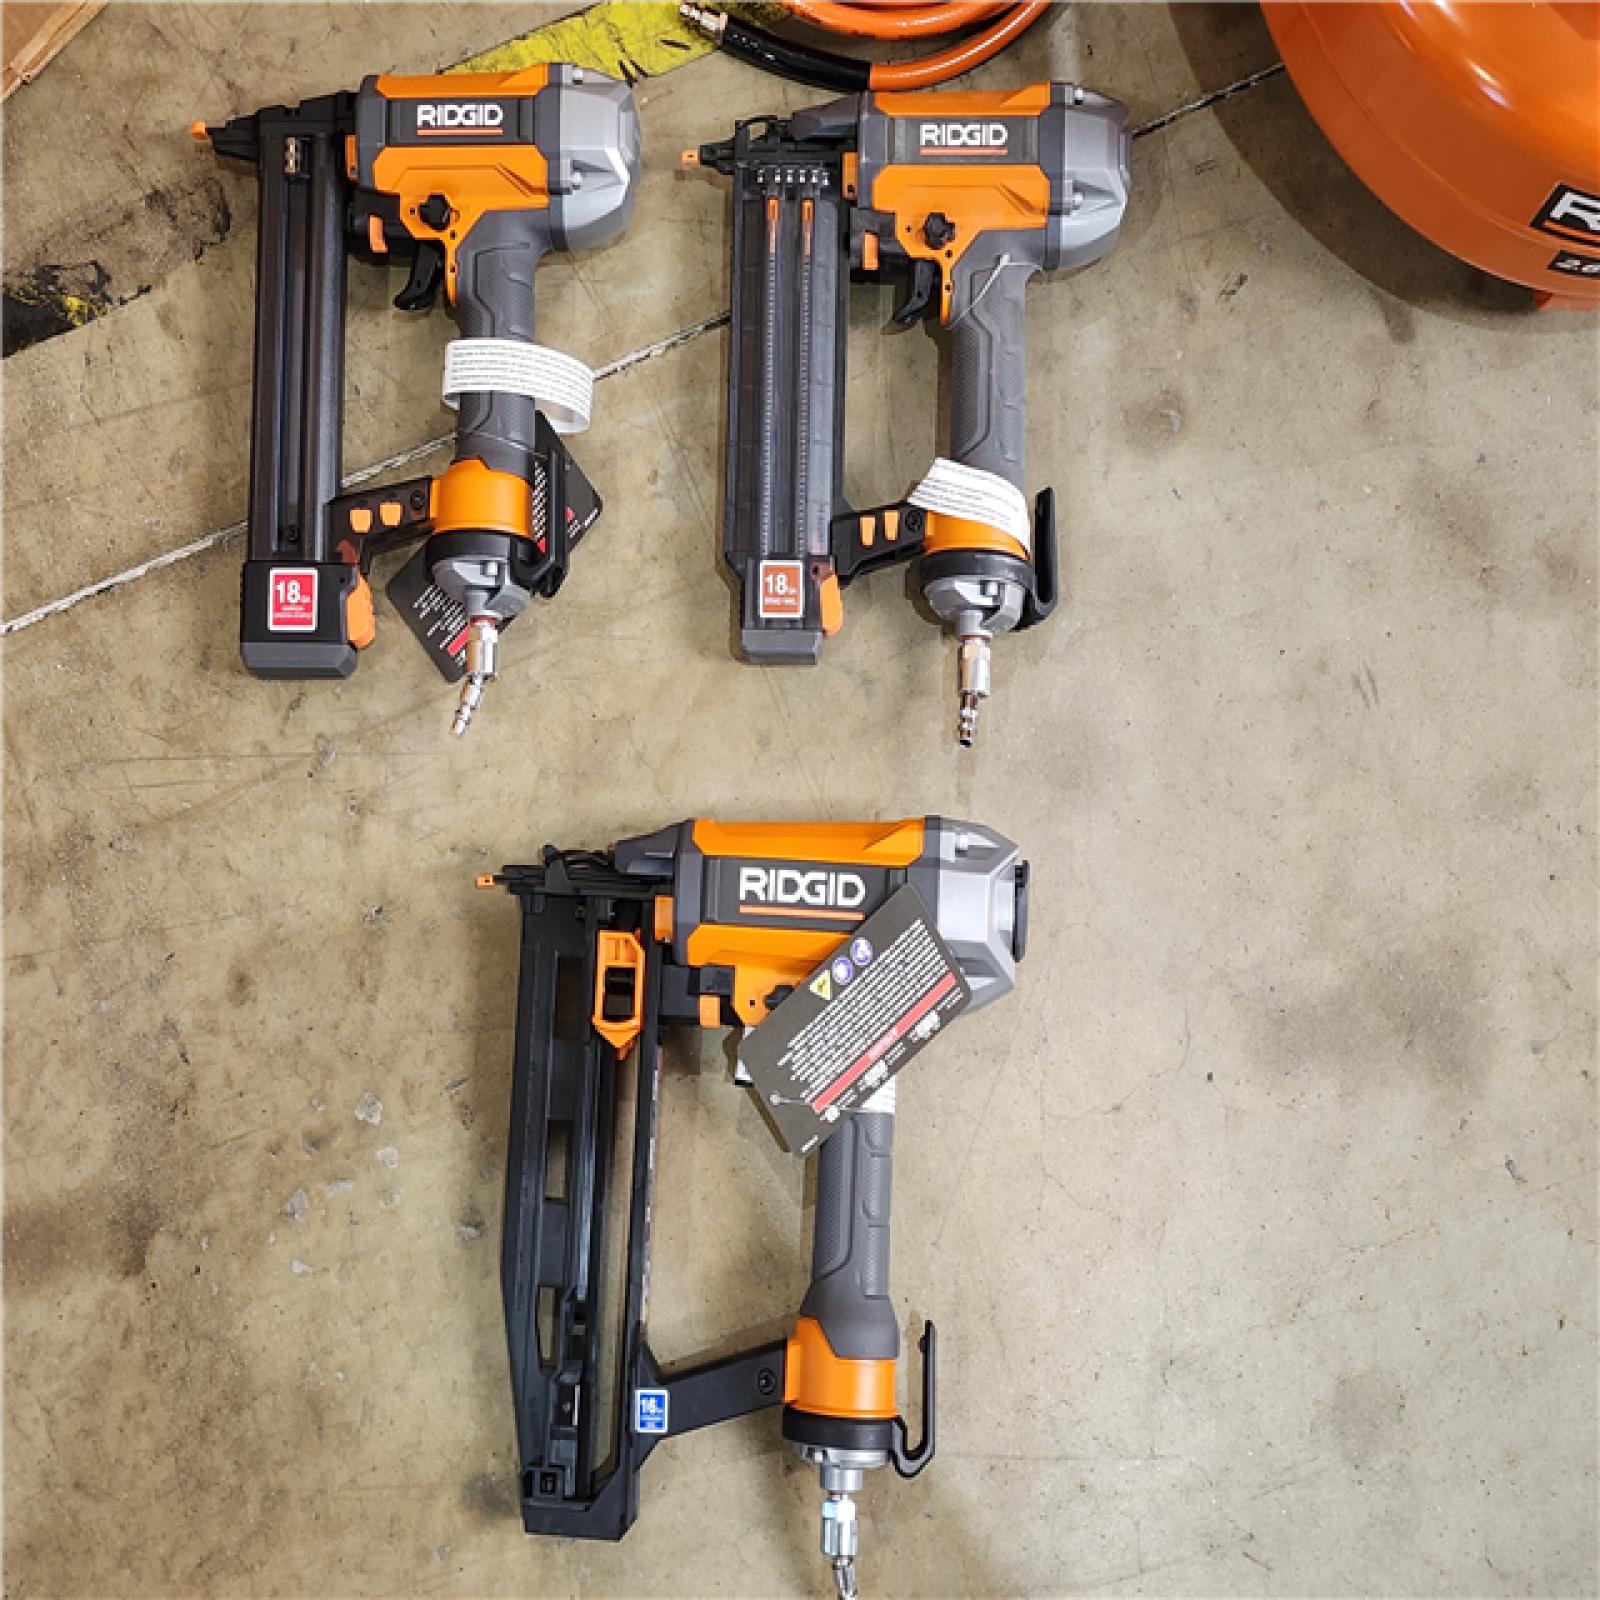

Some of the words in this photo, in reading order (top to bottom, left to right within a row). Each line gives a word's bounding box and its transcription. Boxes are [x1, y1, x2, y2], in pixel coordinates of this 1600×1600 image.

[417, 104, 503, 126] RIDGID
[920, 123, 1008, 146] RIDGID
[274, 579, 300, 604] 18
[764, 572, 788, 595] 18
[740, 867, 866, 906] RIDGID
